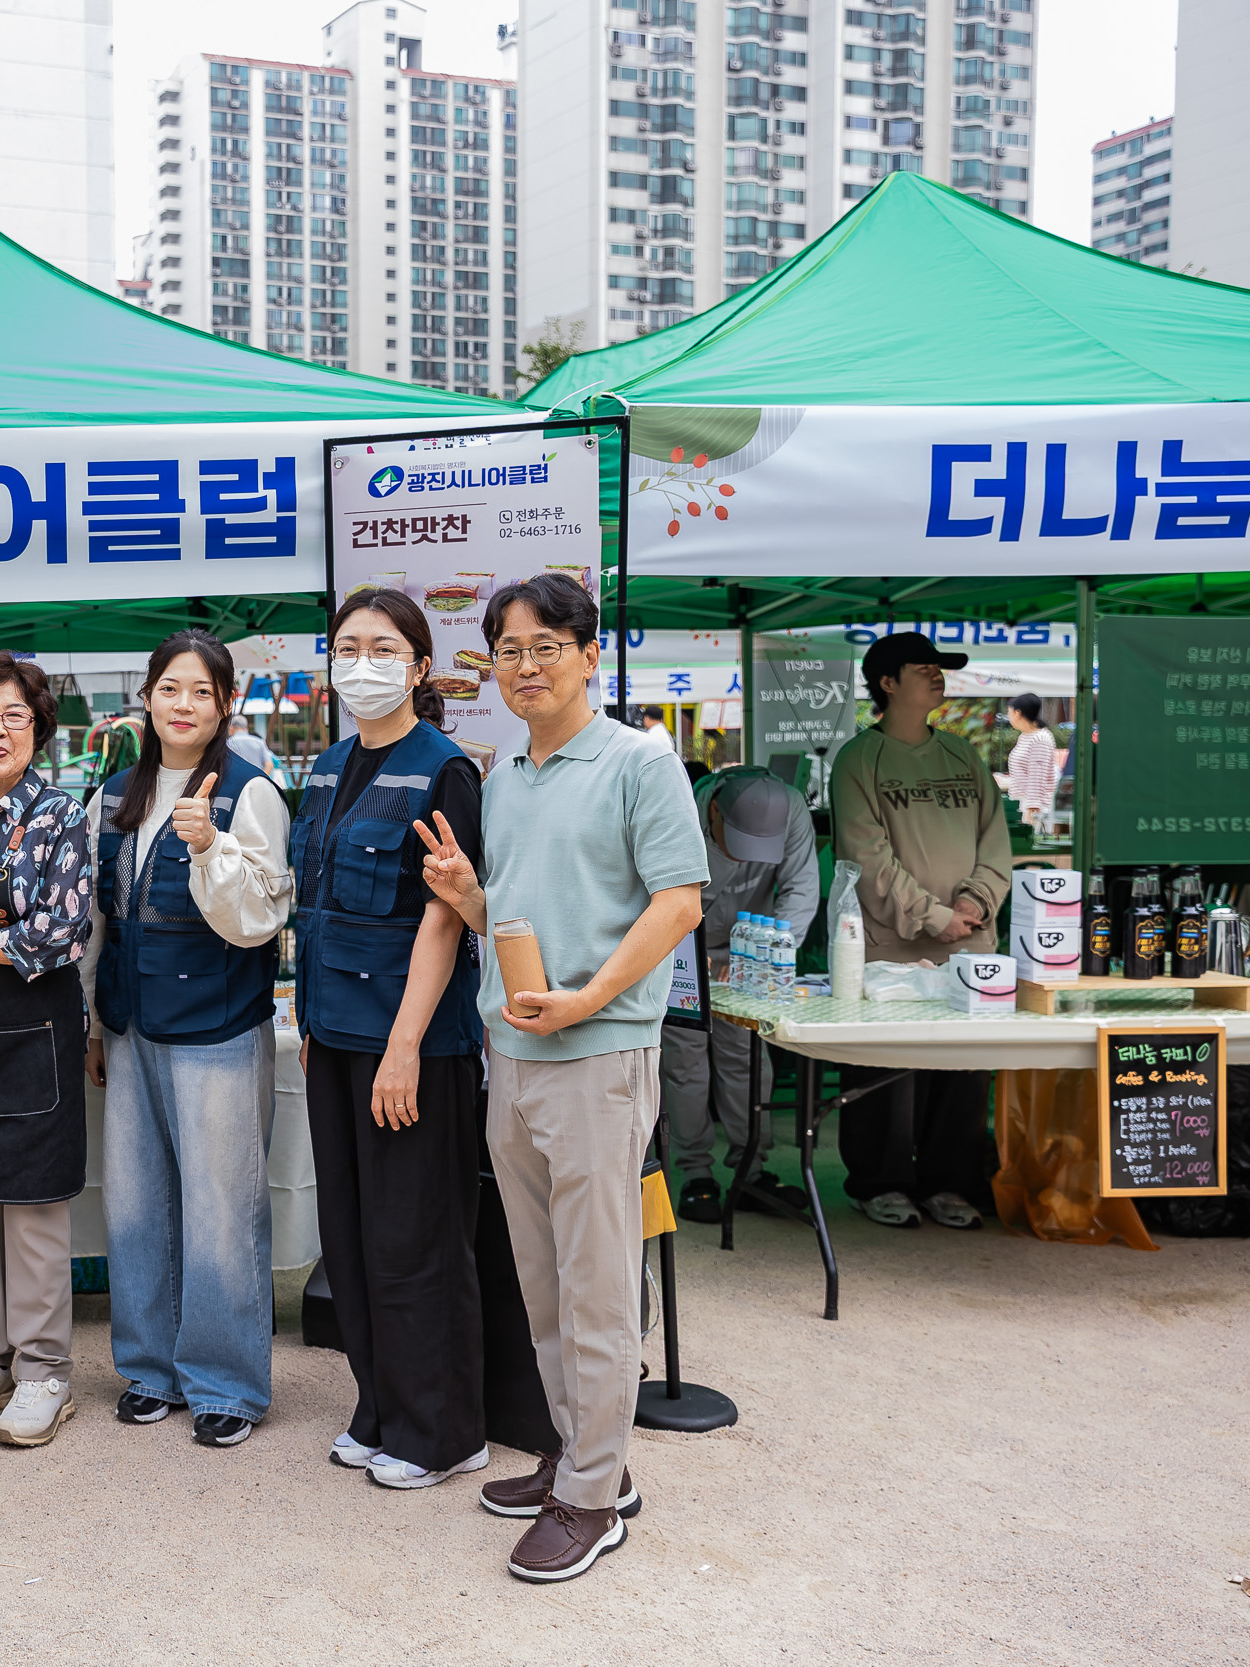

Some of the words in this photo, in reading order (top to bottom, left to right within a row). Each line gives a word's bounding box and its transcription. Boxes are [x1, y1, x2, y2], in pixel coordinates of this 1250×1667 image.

[407, 463, 549, 493] 광진시니어클럽
[925, 440, 1250, 542] 더나눔
[515, 506, 566, 522] 전화주문
[352, 514, 472, 549] 건찬맛찬
[499, 523, 582, 539] 02-6463-1716
[442, 708, 465, 717] 끼치킨
[1160, 1045, 1193, 1063] 커피
